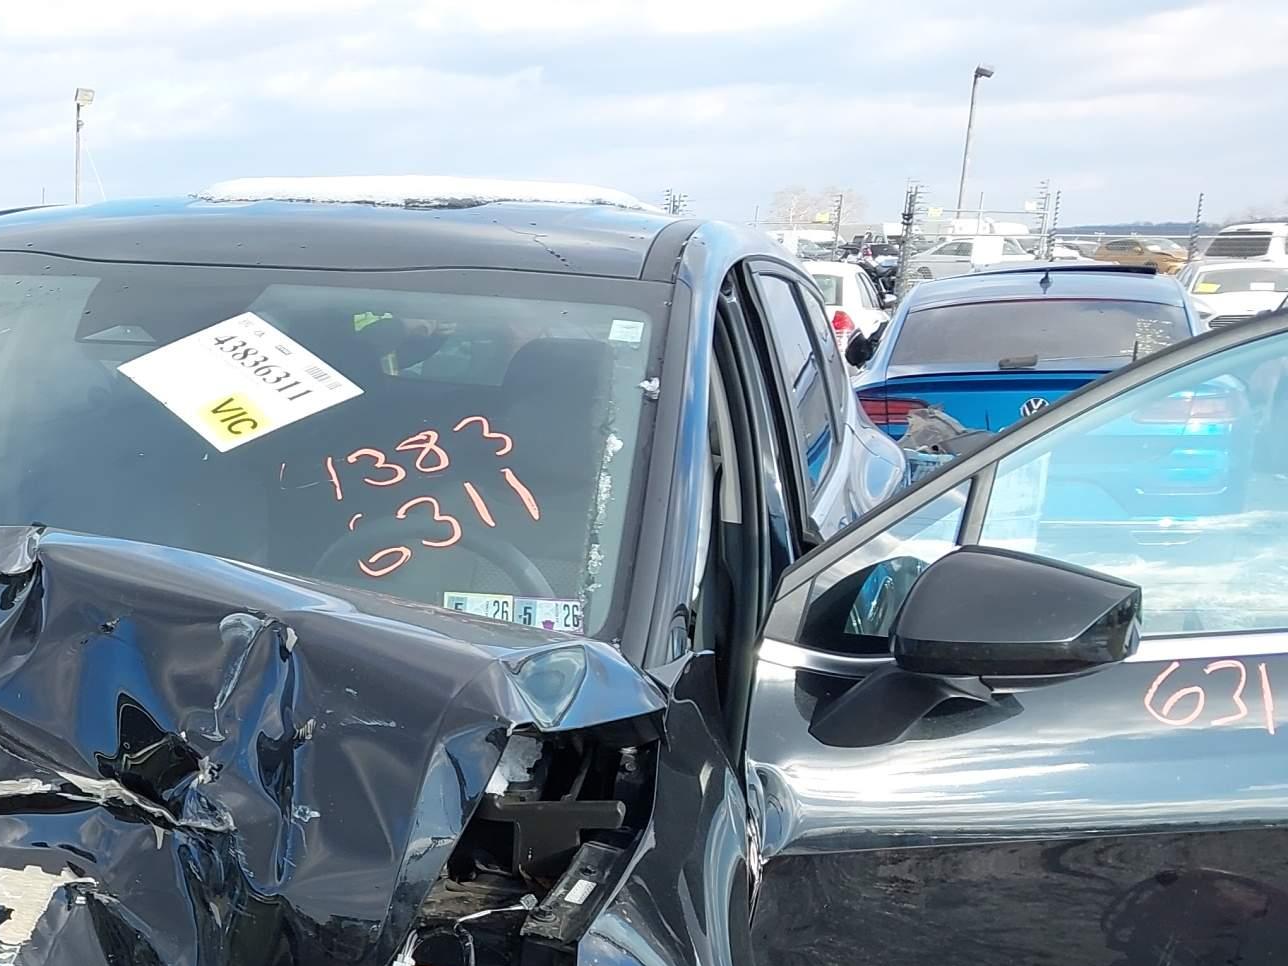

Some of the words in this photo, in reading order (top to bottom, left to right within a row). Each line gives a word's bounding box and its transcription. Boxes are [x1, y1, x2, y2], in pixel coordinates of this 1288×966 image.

[213, 335, 313, 401] 43836311
[211, 397, 258, 435] VIC
[1144, 659, 1276, 735] 631
